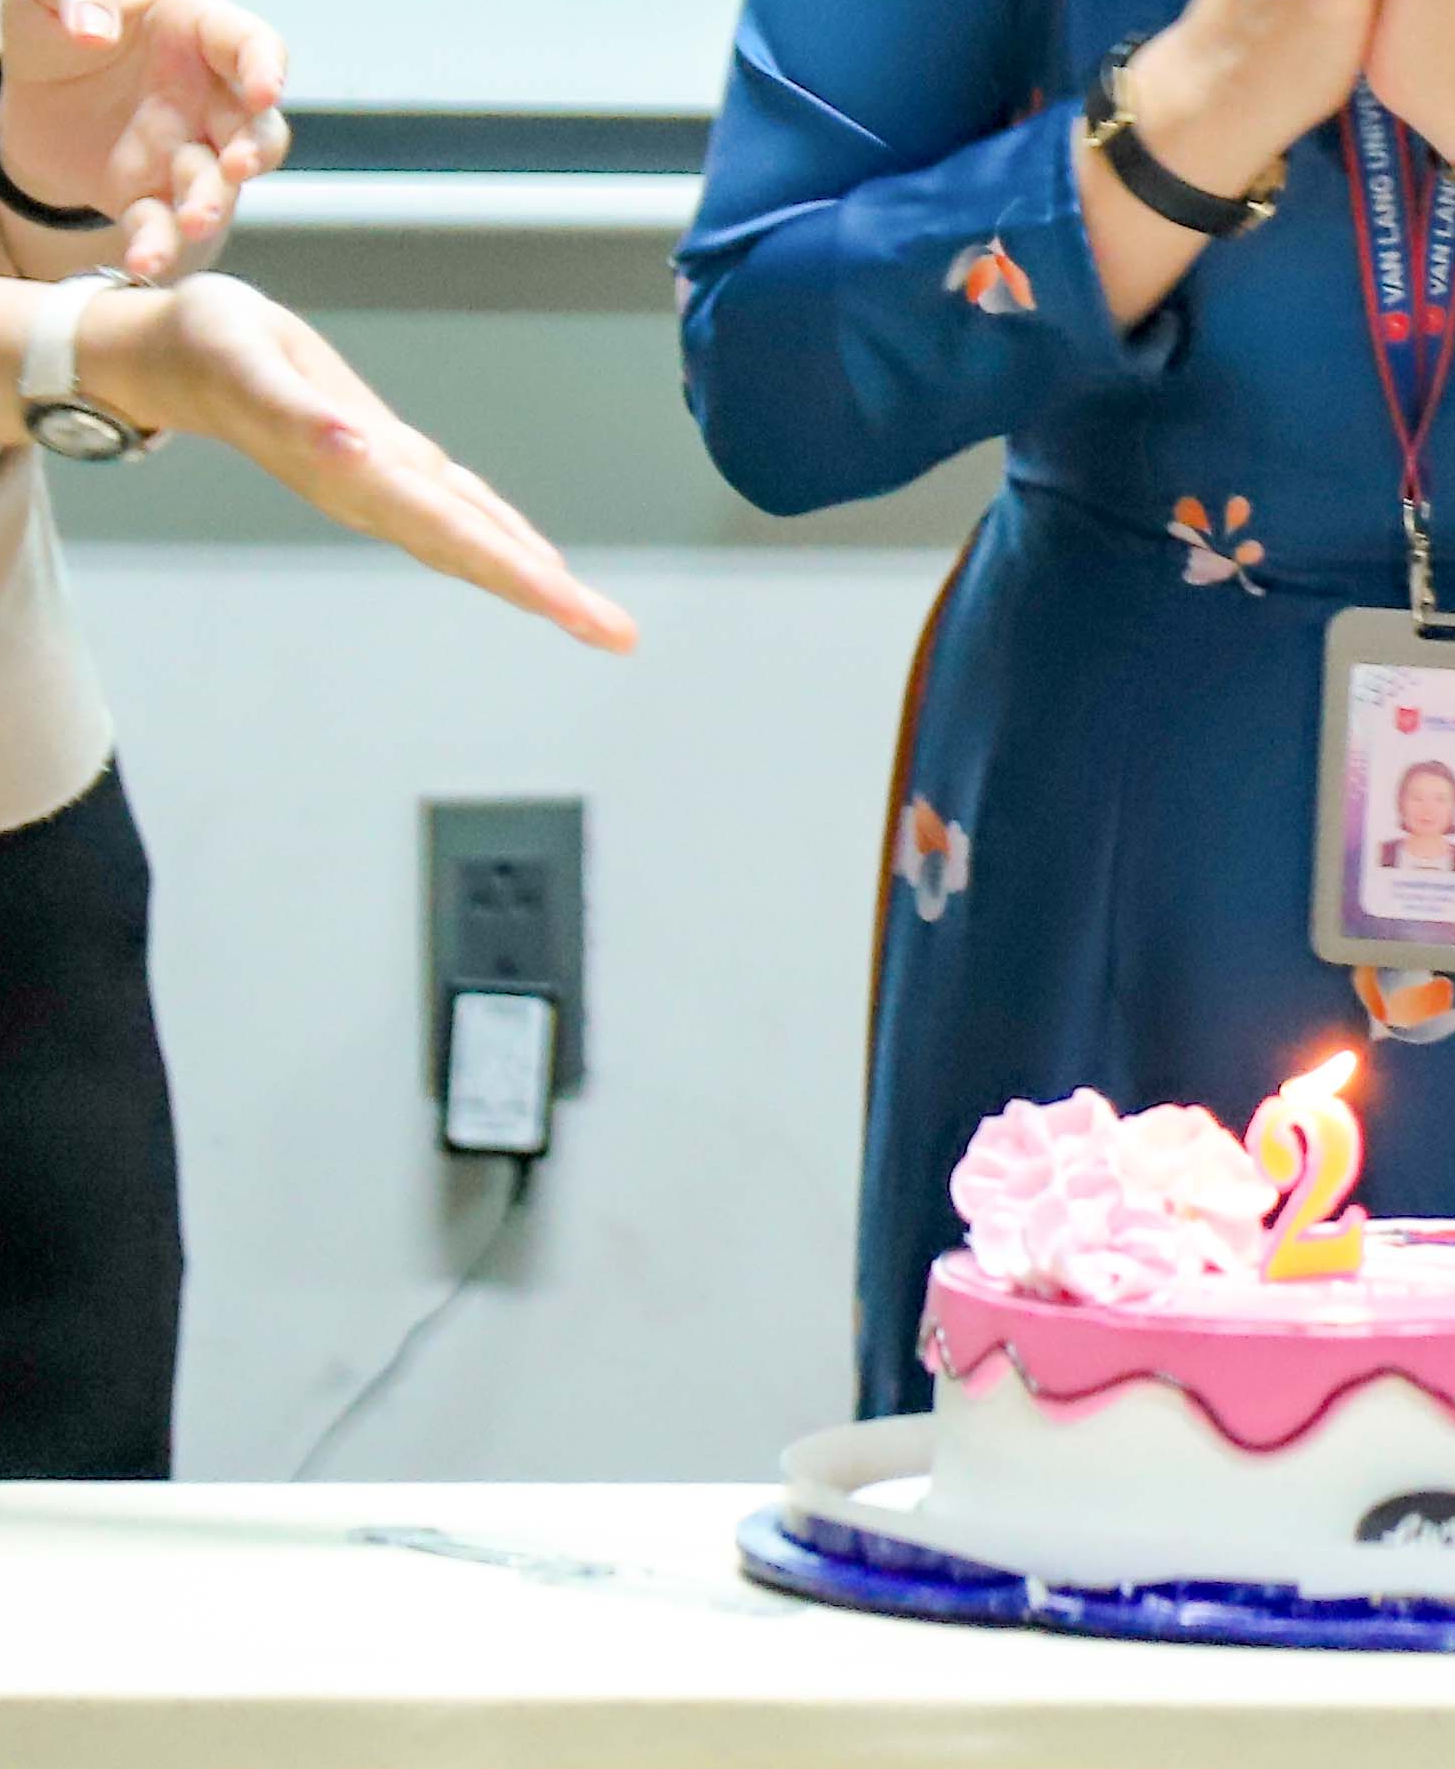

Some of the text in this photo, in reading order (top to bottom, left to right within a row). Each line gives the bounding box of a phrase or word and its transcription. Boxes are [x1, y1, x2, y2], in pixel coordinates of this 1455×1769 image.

[1369, 174, 1401, 246] LANG
[1378, 251, 1407, 305] VAN
[1430, 243, 1453, 296] VAN
[1245, 1091, 1367, 1282] 2
